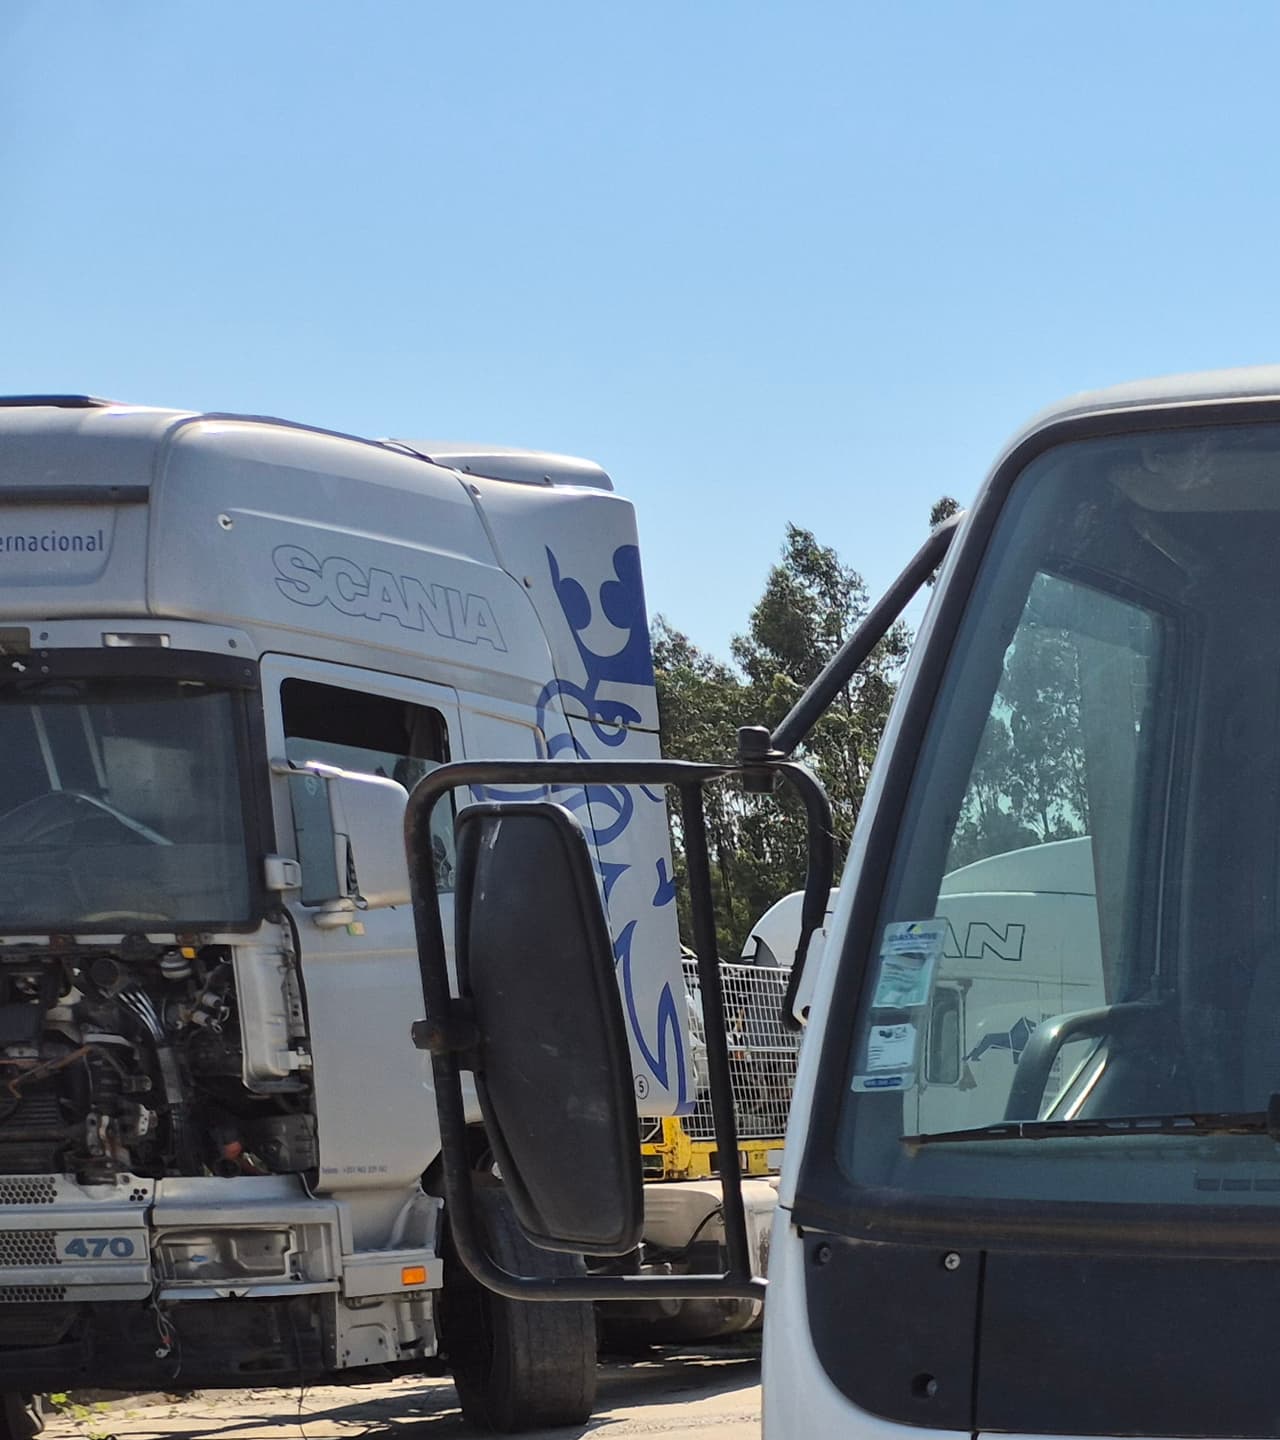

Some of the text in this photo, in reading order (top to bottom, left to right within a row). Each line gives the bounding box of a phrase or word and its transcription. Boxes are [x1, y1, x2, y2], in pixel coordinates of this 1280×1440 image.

[0, 529, 103, 552] rnacional
[272, 544, 508, 652] SCANIA
[64, 1237, 135, 1257] 470
